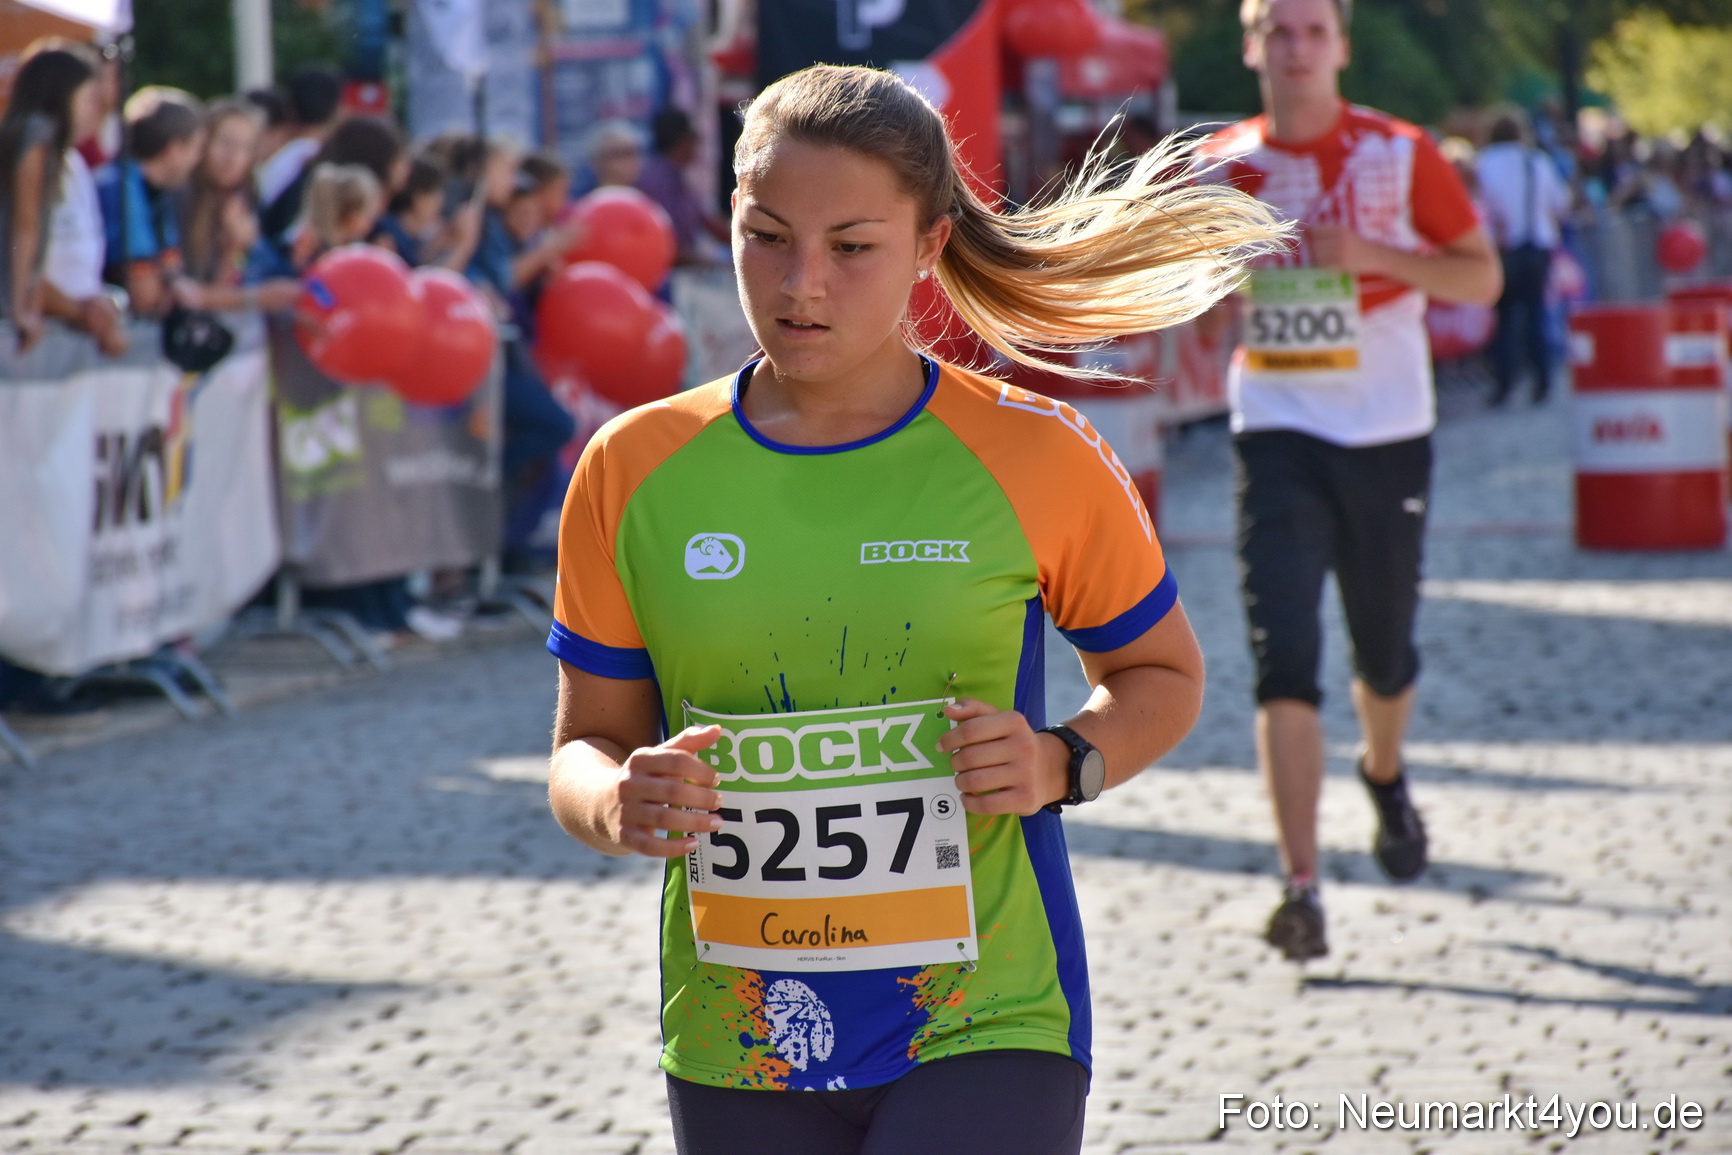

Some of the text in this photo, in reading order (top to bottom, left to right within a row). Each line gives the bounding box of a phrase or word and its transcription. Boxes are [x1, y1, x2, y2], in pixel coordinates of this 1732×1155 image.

[1252, 306, 1345, 344] 5200
[860, 540, 971, 564] BOCK
[696, 713, 934, 783] BOCK
[708, 796, 925, 882] 5257
[760, 911, 869, 947] Carolina
